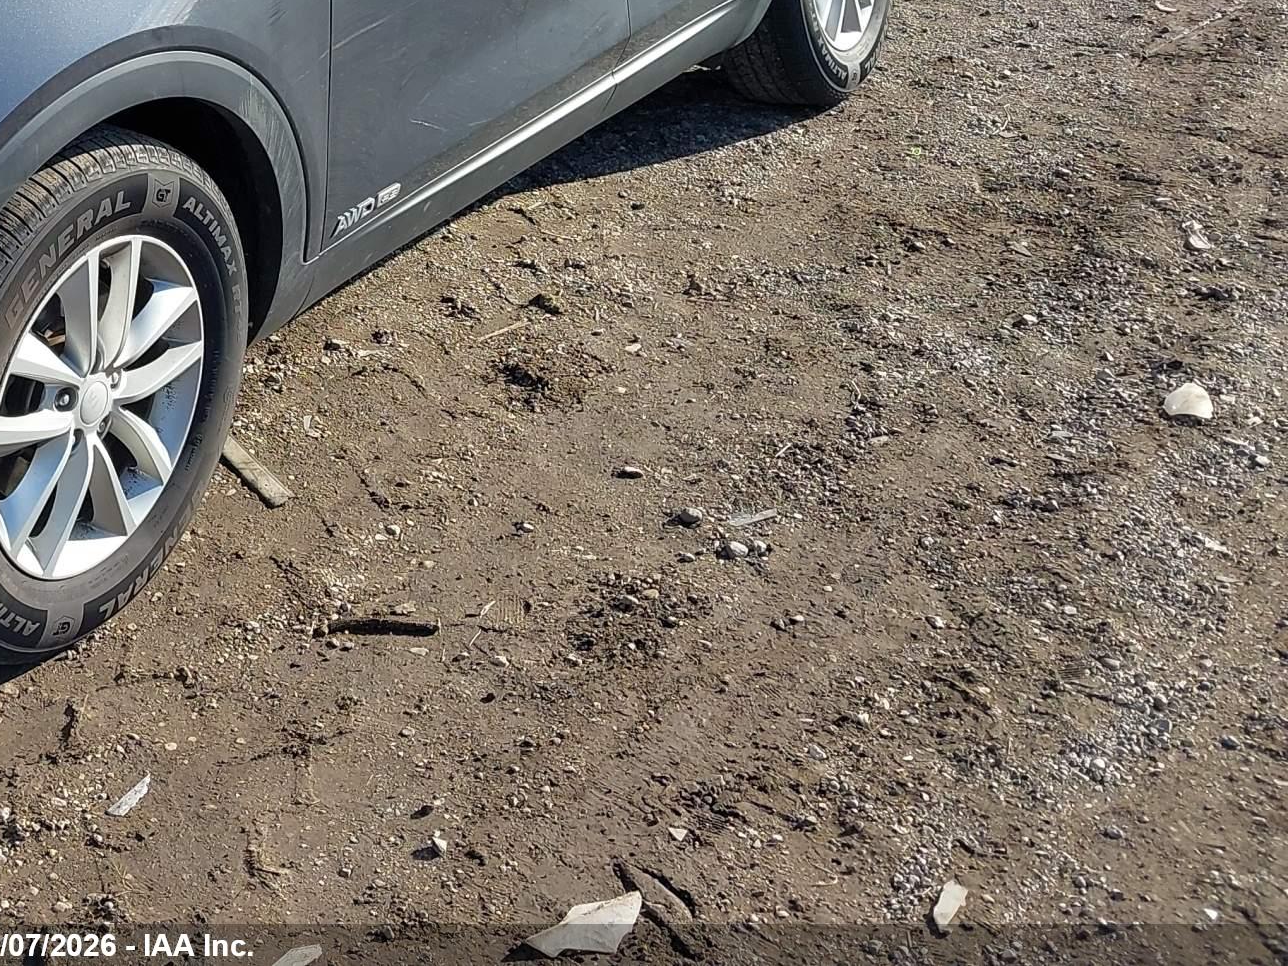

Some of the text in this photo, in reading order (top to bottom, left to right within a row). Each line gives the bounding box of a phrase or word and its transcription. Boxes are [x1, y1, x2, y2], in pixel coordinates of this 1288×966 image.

[182, 196, 237, 277] ALTIMAX
[329, 197, 375, 239] AWD
[5, 191, 131, 329] GENERAL
